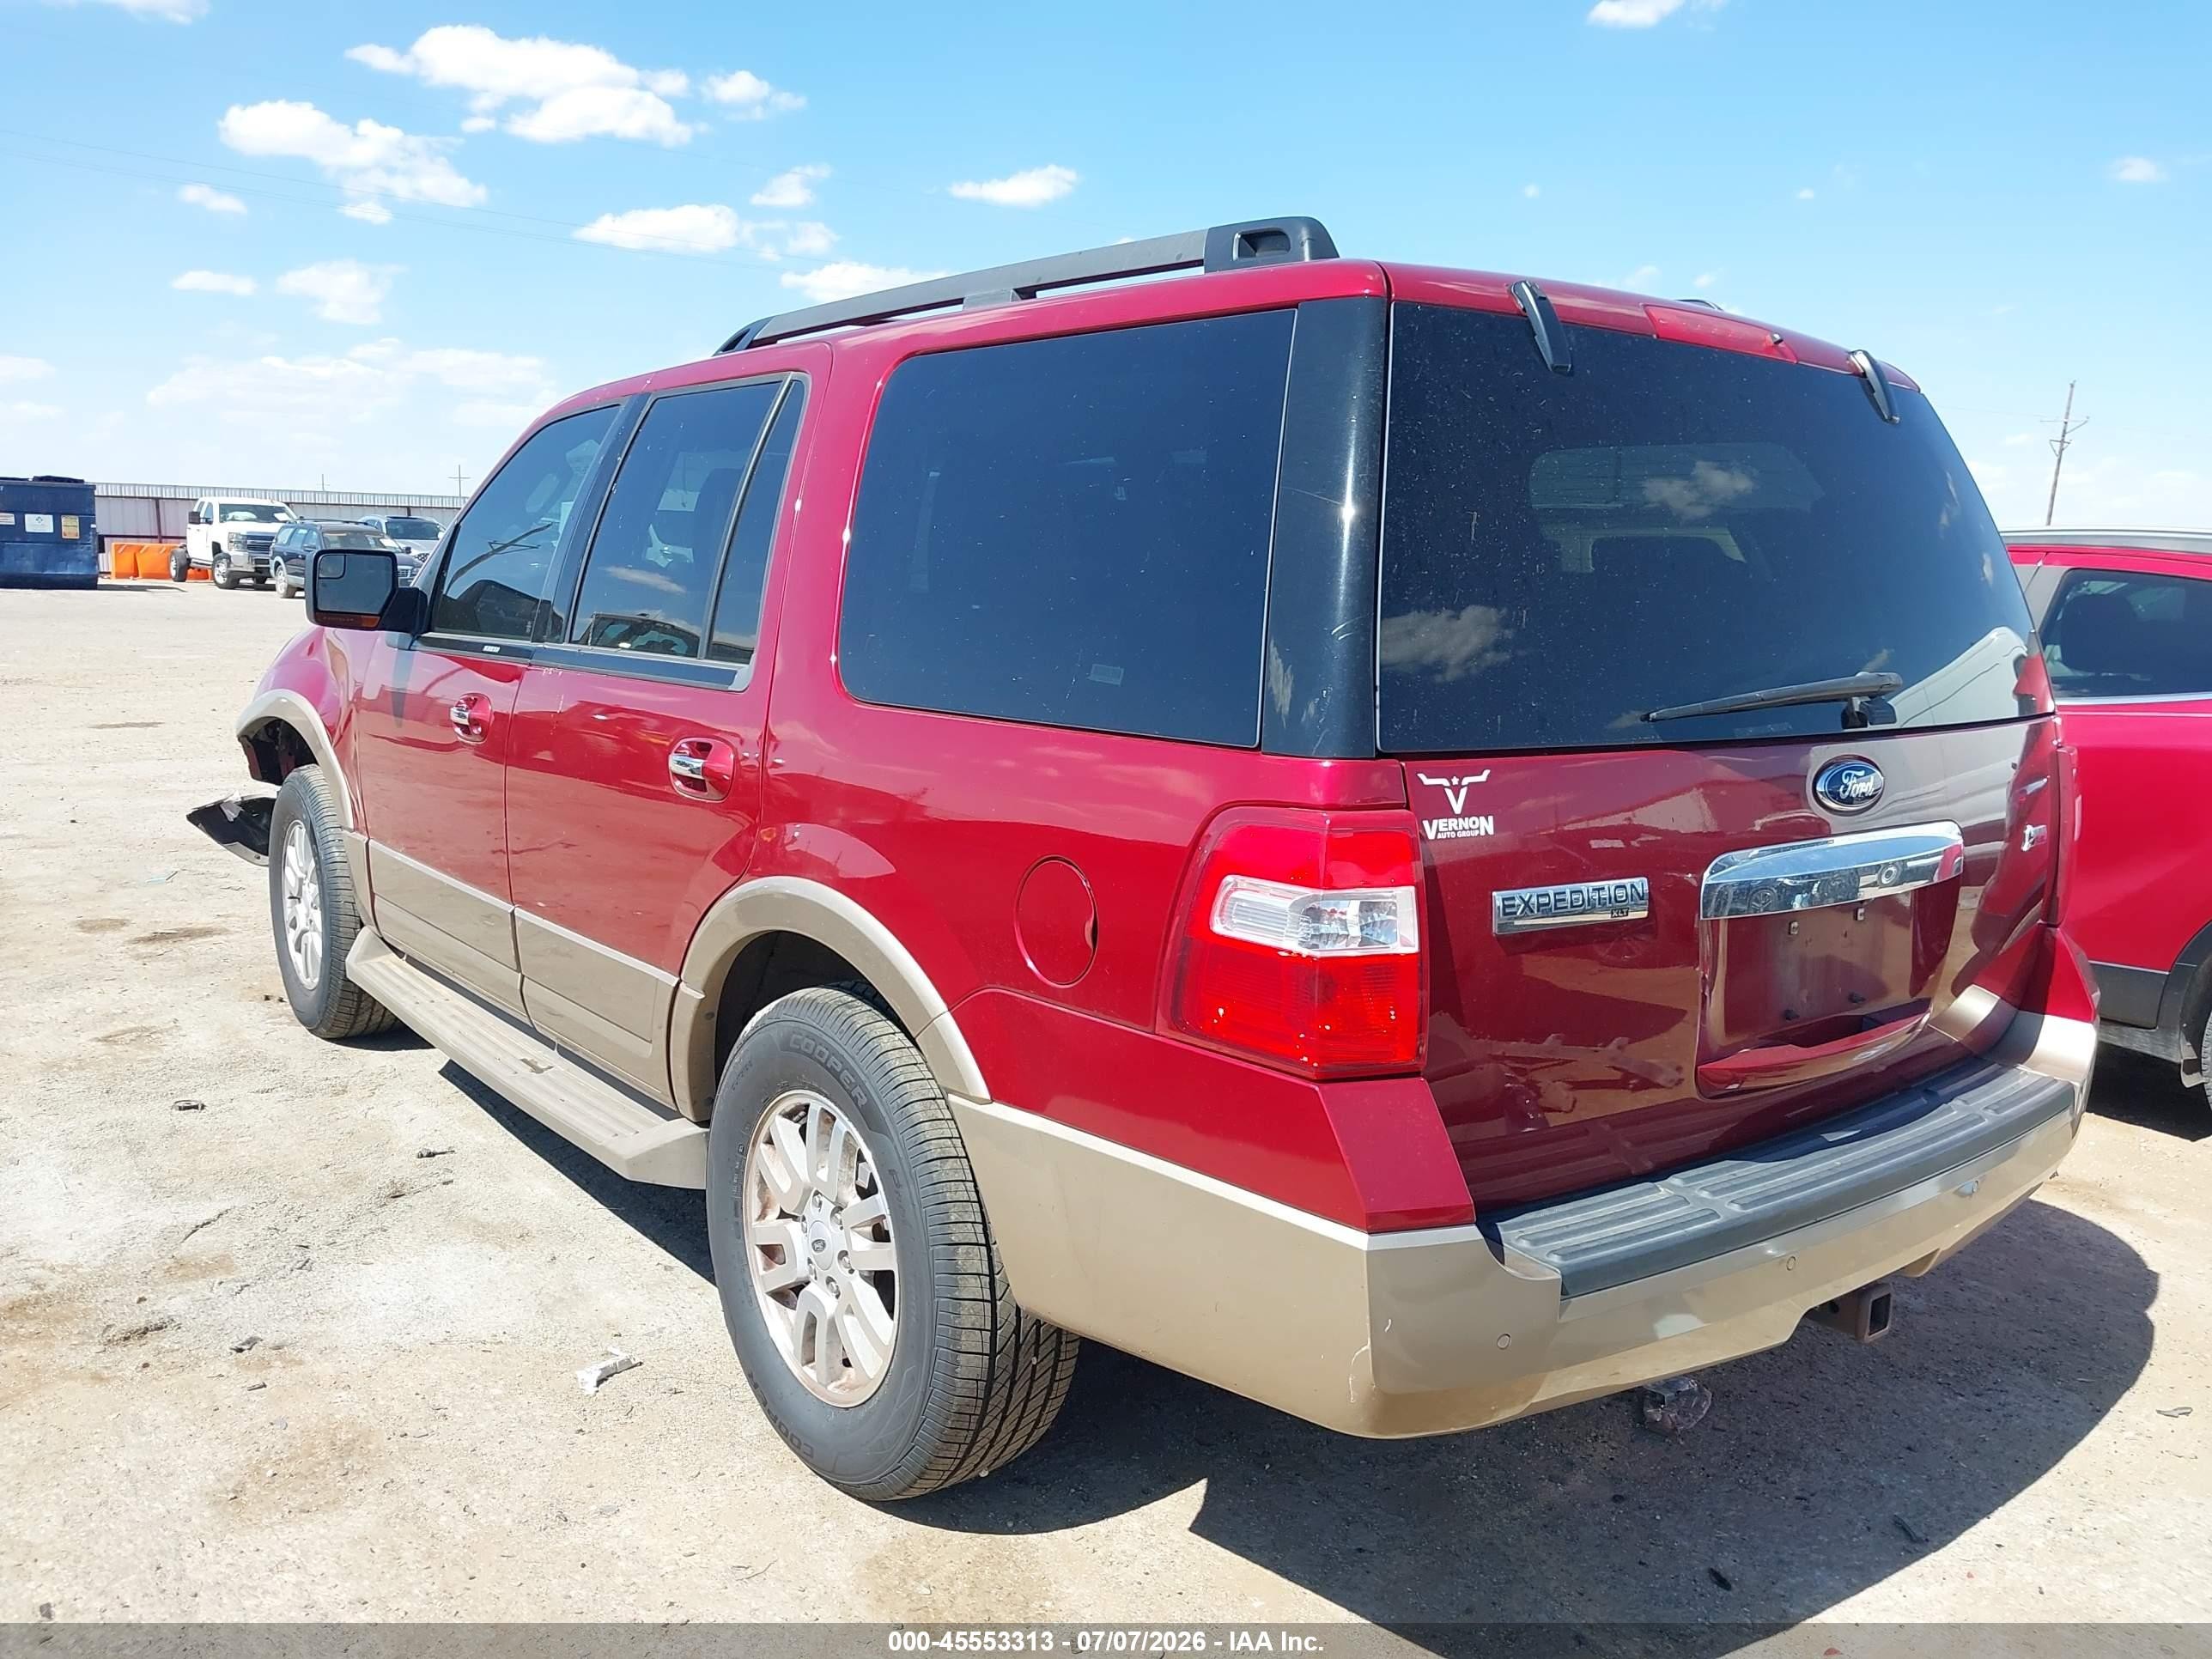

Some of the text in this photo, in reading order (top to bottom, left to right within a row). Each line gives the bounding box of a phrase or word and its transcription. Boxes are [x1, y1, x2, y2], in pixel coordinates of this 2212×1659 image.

[1839, 769, 1875, 799] Ford
[1422, 815, 1494, 840] VERNON
[1437, 830, 1480, 840] AUTO GROUP
[1500, 881, 1646, 918] EXPEDITION
[1611, 908, 1630, 918] XLT
[788, 1033, 868, 1108] COOPER
